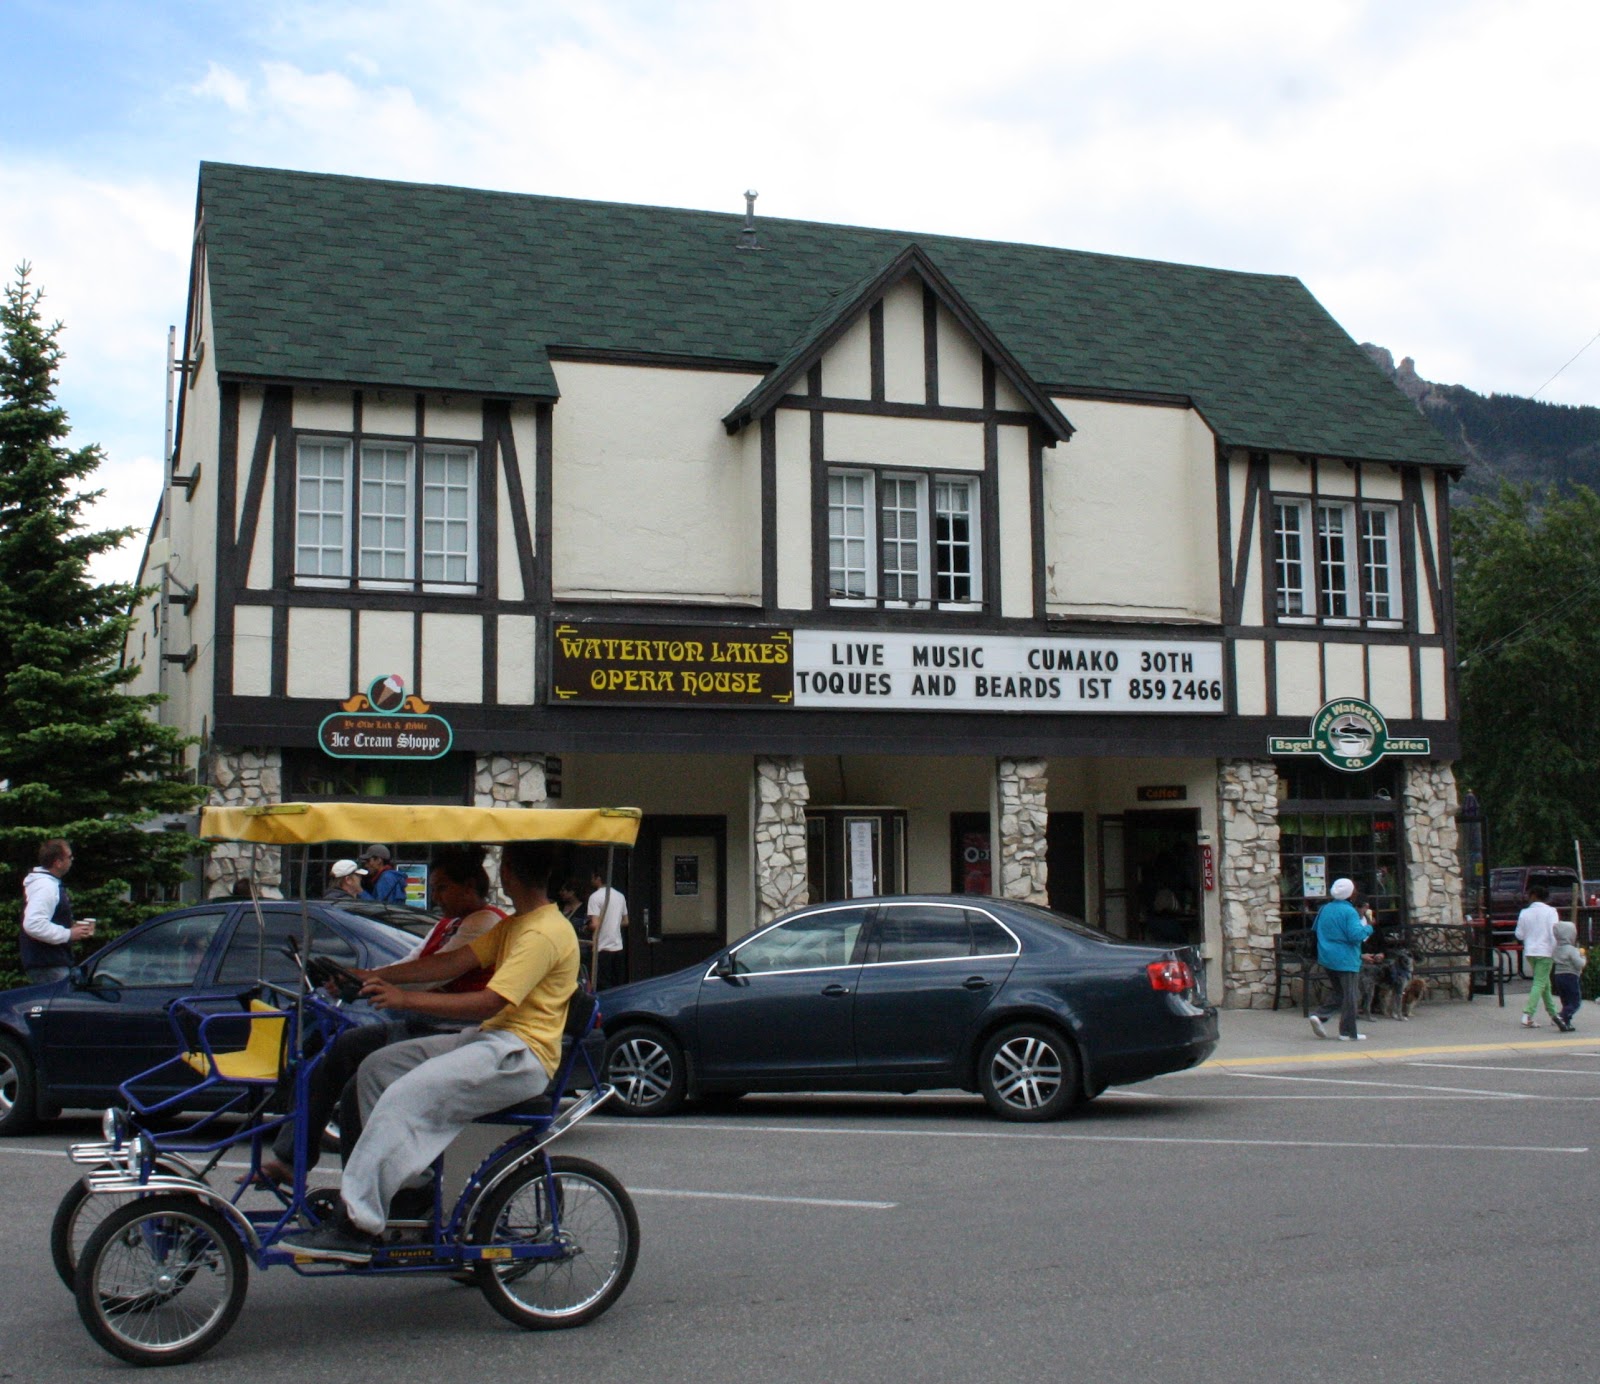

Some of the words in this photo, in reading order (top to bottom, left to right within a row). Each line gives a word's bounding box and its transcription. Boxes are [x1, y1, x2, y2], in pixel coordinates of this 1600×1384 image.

[559, 638, 704, 662] WATERTON
[710, 642, 789, 665] LAKES
[832, 643, 885, 666] LIVE
[913, 645, 984, 669] MUSIC
[1028, 648, 1119, 672] CUMAKO
[1140, 651, 1194, 674] 30TH
[590, 669, 675, 692] OPERA
[681, 671, 762, 696] HOUSE
[797, 671, 892, 697] TOQUES
[912, 674, 956, 697] AND
[975, 675, 1061, 699] BEARDS
[394, 722, 401, 730] &
[1319, 714, 1332, 731] THE
[1331, 703, 1382, 732] Waterton
[331, 732, 350, 748] Ice
[354, 733, 393, 748] Cream
[396, 733, 441, 751] Shoppe
[1275, 740, 1313, 752] Bagel
[1316, 740, 1327, 750] &
[1383, 740, 1425, 750] Coffee
[1203, 849, 1213, 887] OPEN
